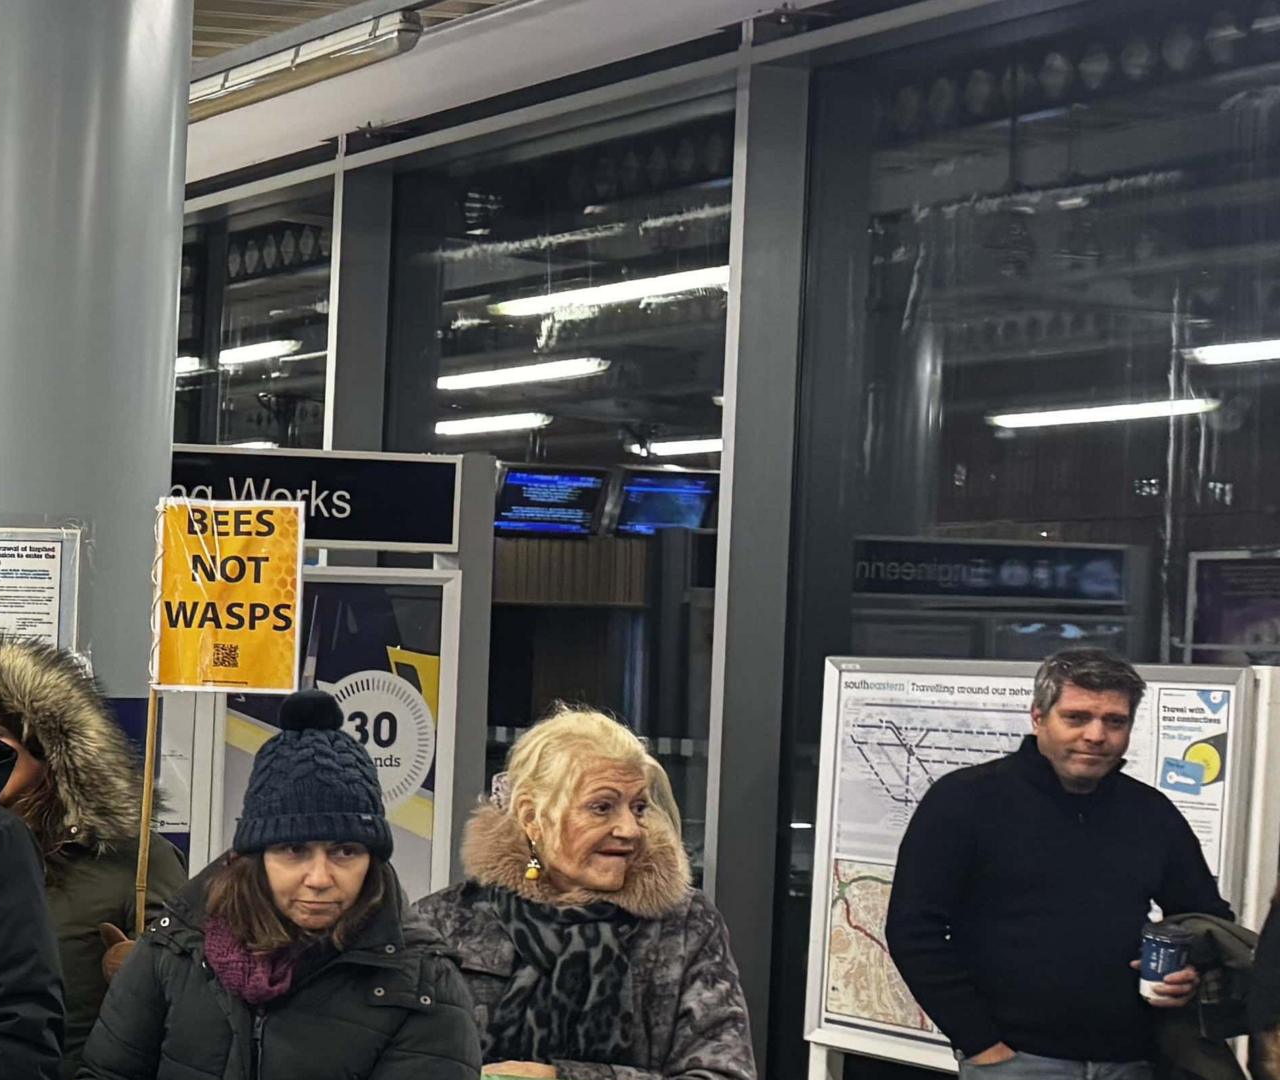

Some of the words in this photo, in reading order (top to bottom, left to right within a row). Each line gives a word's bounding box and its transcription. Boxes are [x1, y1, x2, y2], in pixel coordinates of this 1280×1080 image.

[187, 508, 276, 537] BEES
[191, 554, 270, 584] NOT
[163, 600, 293, 632] WASPS
[911, 683, 955, 695] Travelling
[956, 685, 990, 695] around
[991, 687, 1007, 695] our
[347, 711, 398, 749] 30
